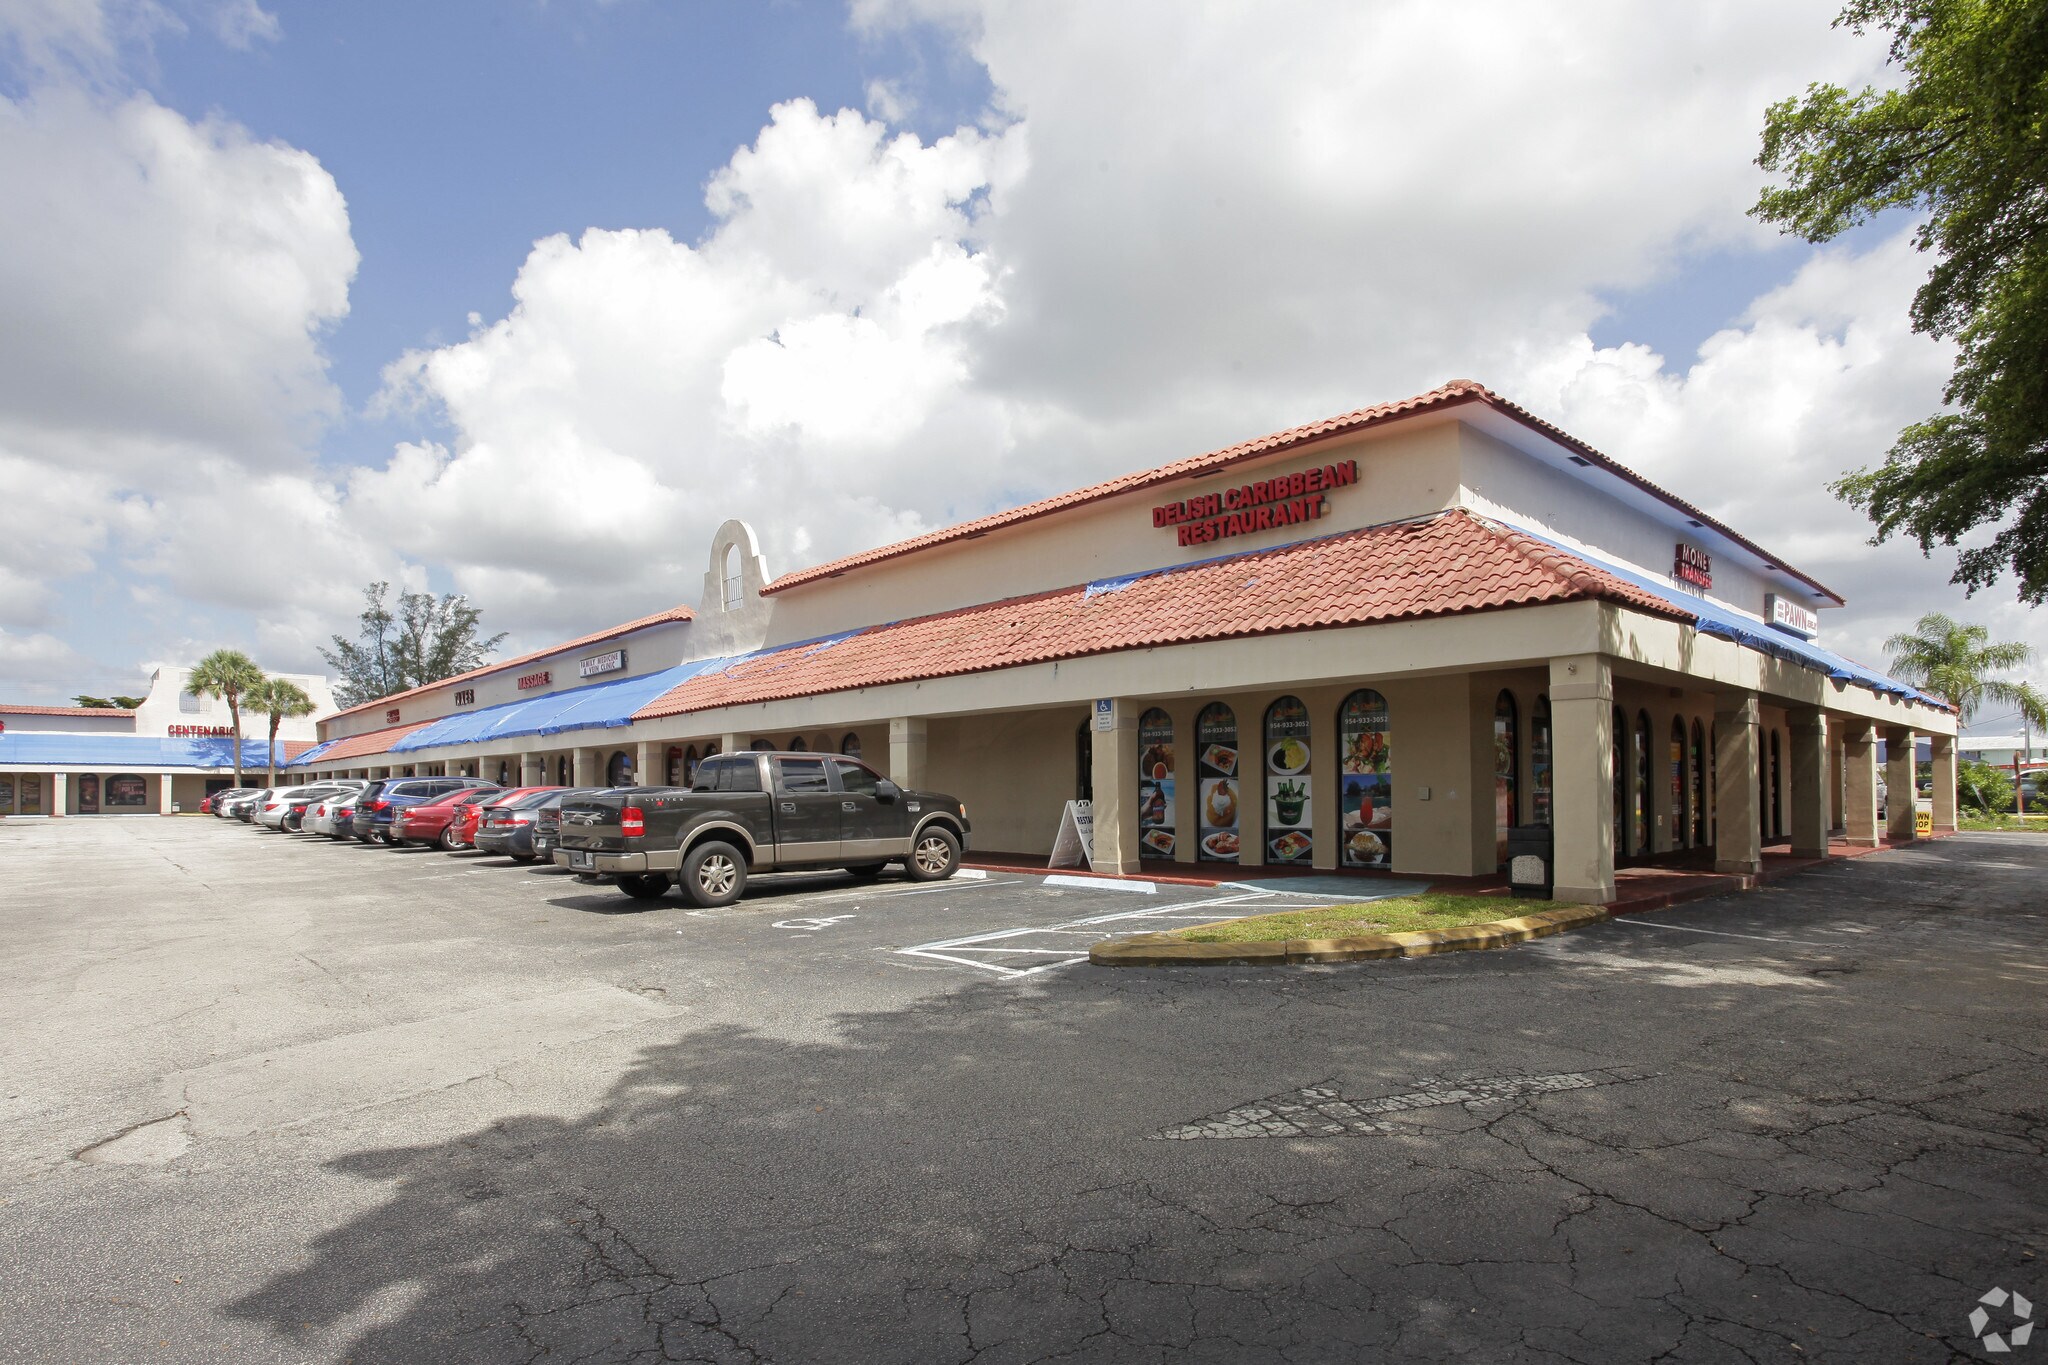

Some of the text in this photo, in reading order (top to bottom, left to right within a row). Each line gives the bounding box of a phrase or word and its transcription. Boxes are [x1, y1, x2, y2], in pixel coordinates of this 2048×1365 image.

[1153, 460, 1357, 528] DELISH CARIBBEAN
[1178, 495, 1325, 546] RESTAURANT
[1682, 543, 1712, 571] MONEY
[1681, 562, 1712, 589] TRANSFER
[1784, 601, 1807, 630] PAWN
[597, 652, 618, 665] MEDICINE
[518, 671, 549, 690] MASSAGE
[1270, 721, 1310, 729] 954-933-3052
[1345, 716, 1388, 725] 954-933-3052
